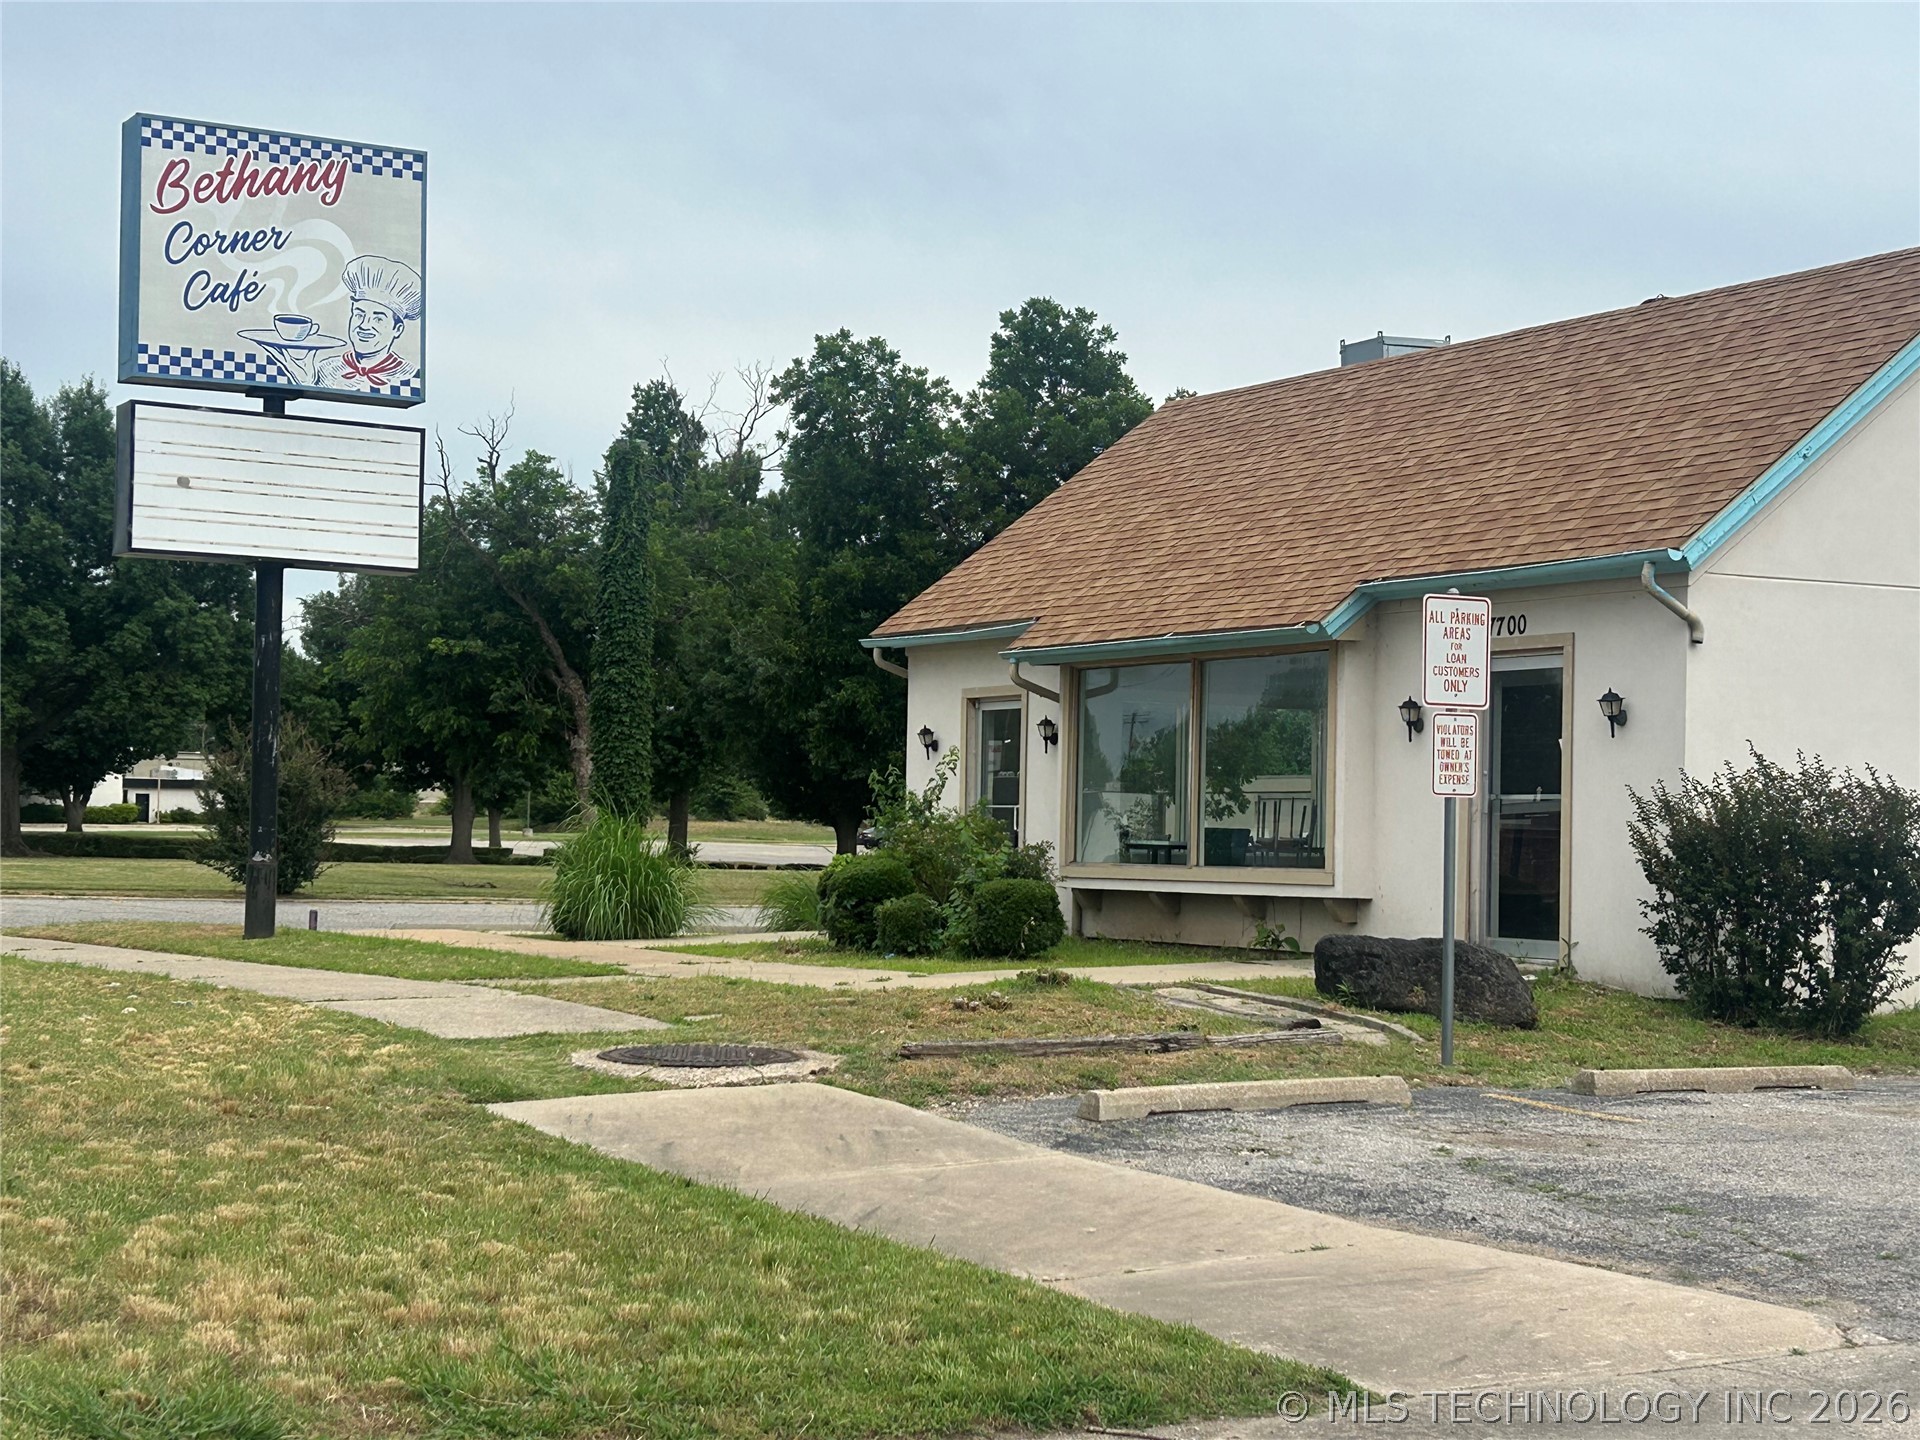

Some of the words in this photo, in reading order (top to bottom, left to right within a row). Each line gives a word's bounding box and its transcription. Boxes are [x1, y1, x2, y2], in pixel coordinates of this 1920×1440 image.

[149, 150, 349, 215] Bethany
[164, 220, 293, 265] Corner
[183, 268, 267, 312] Café
[1429, 610, 1445, 624] ALL
[1450, 611, 1486, 626] PARKING
[1442, 626, 1471, 641] AREAS
[1450, 642, 1463, 651] FOR
[1446, 652, 1467, 664] LOAN
[1432, 665, 1480, 678] CUSTOMERS
[1443, 678, 1468, 693] ONLY
[1436, 724, 1474, 736] VIOLATORS
[1440, 737, 1457, 748] WILL
[1460, 737, 1470, 749] BE
[1436, 749, 1460, 760] TOWED
[1464, 749, 1473, 760] AT
[1438, 774, 1470, 786] EXPENSE
